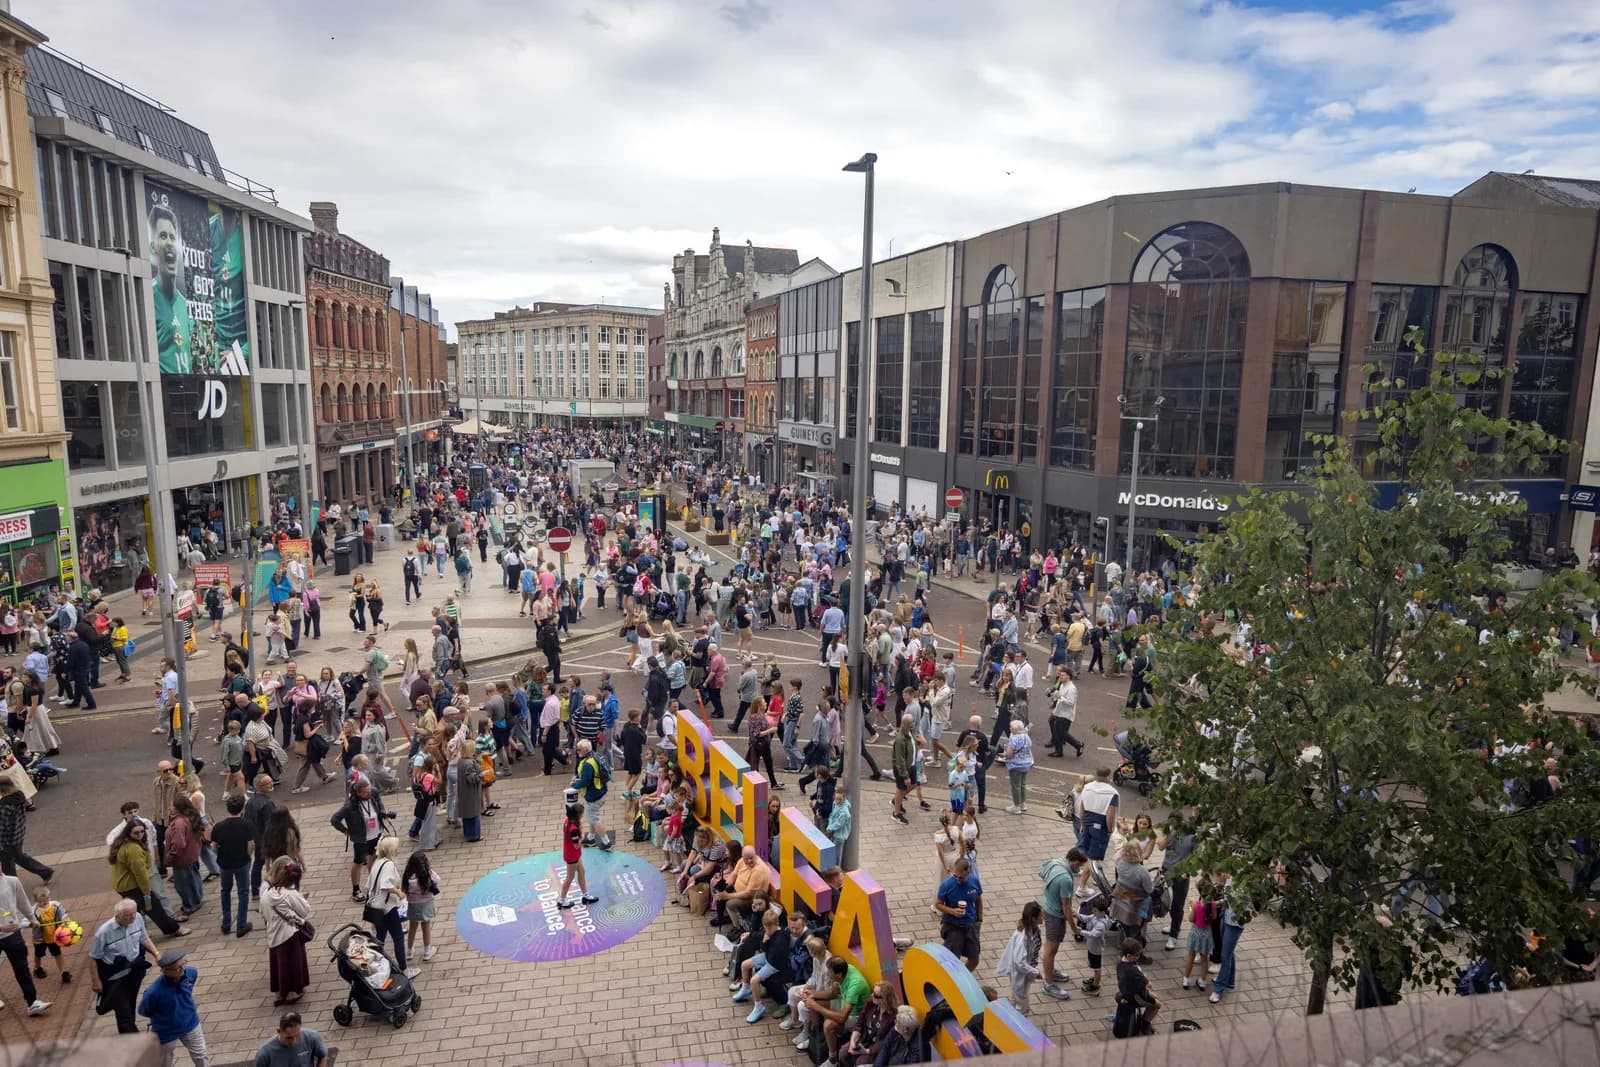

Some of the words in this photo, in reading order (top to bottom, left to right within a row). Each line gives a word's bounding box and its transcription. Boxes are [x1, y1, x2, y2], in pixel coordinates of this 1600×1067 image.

[183, 247, 205, 269] YOU
[194, 275, 216, 297] GOT
[186, 300, 213, 322] THIS
[198, 380, 227, 420] JD
[821, 432, 832, 445] G
[213, 460, 228, 480] JD
[1118, 491, 1229, 511] McDonald's
[533, 878, 552, 891] to
[677, 709, 1056, 1060] BELFAS
